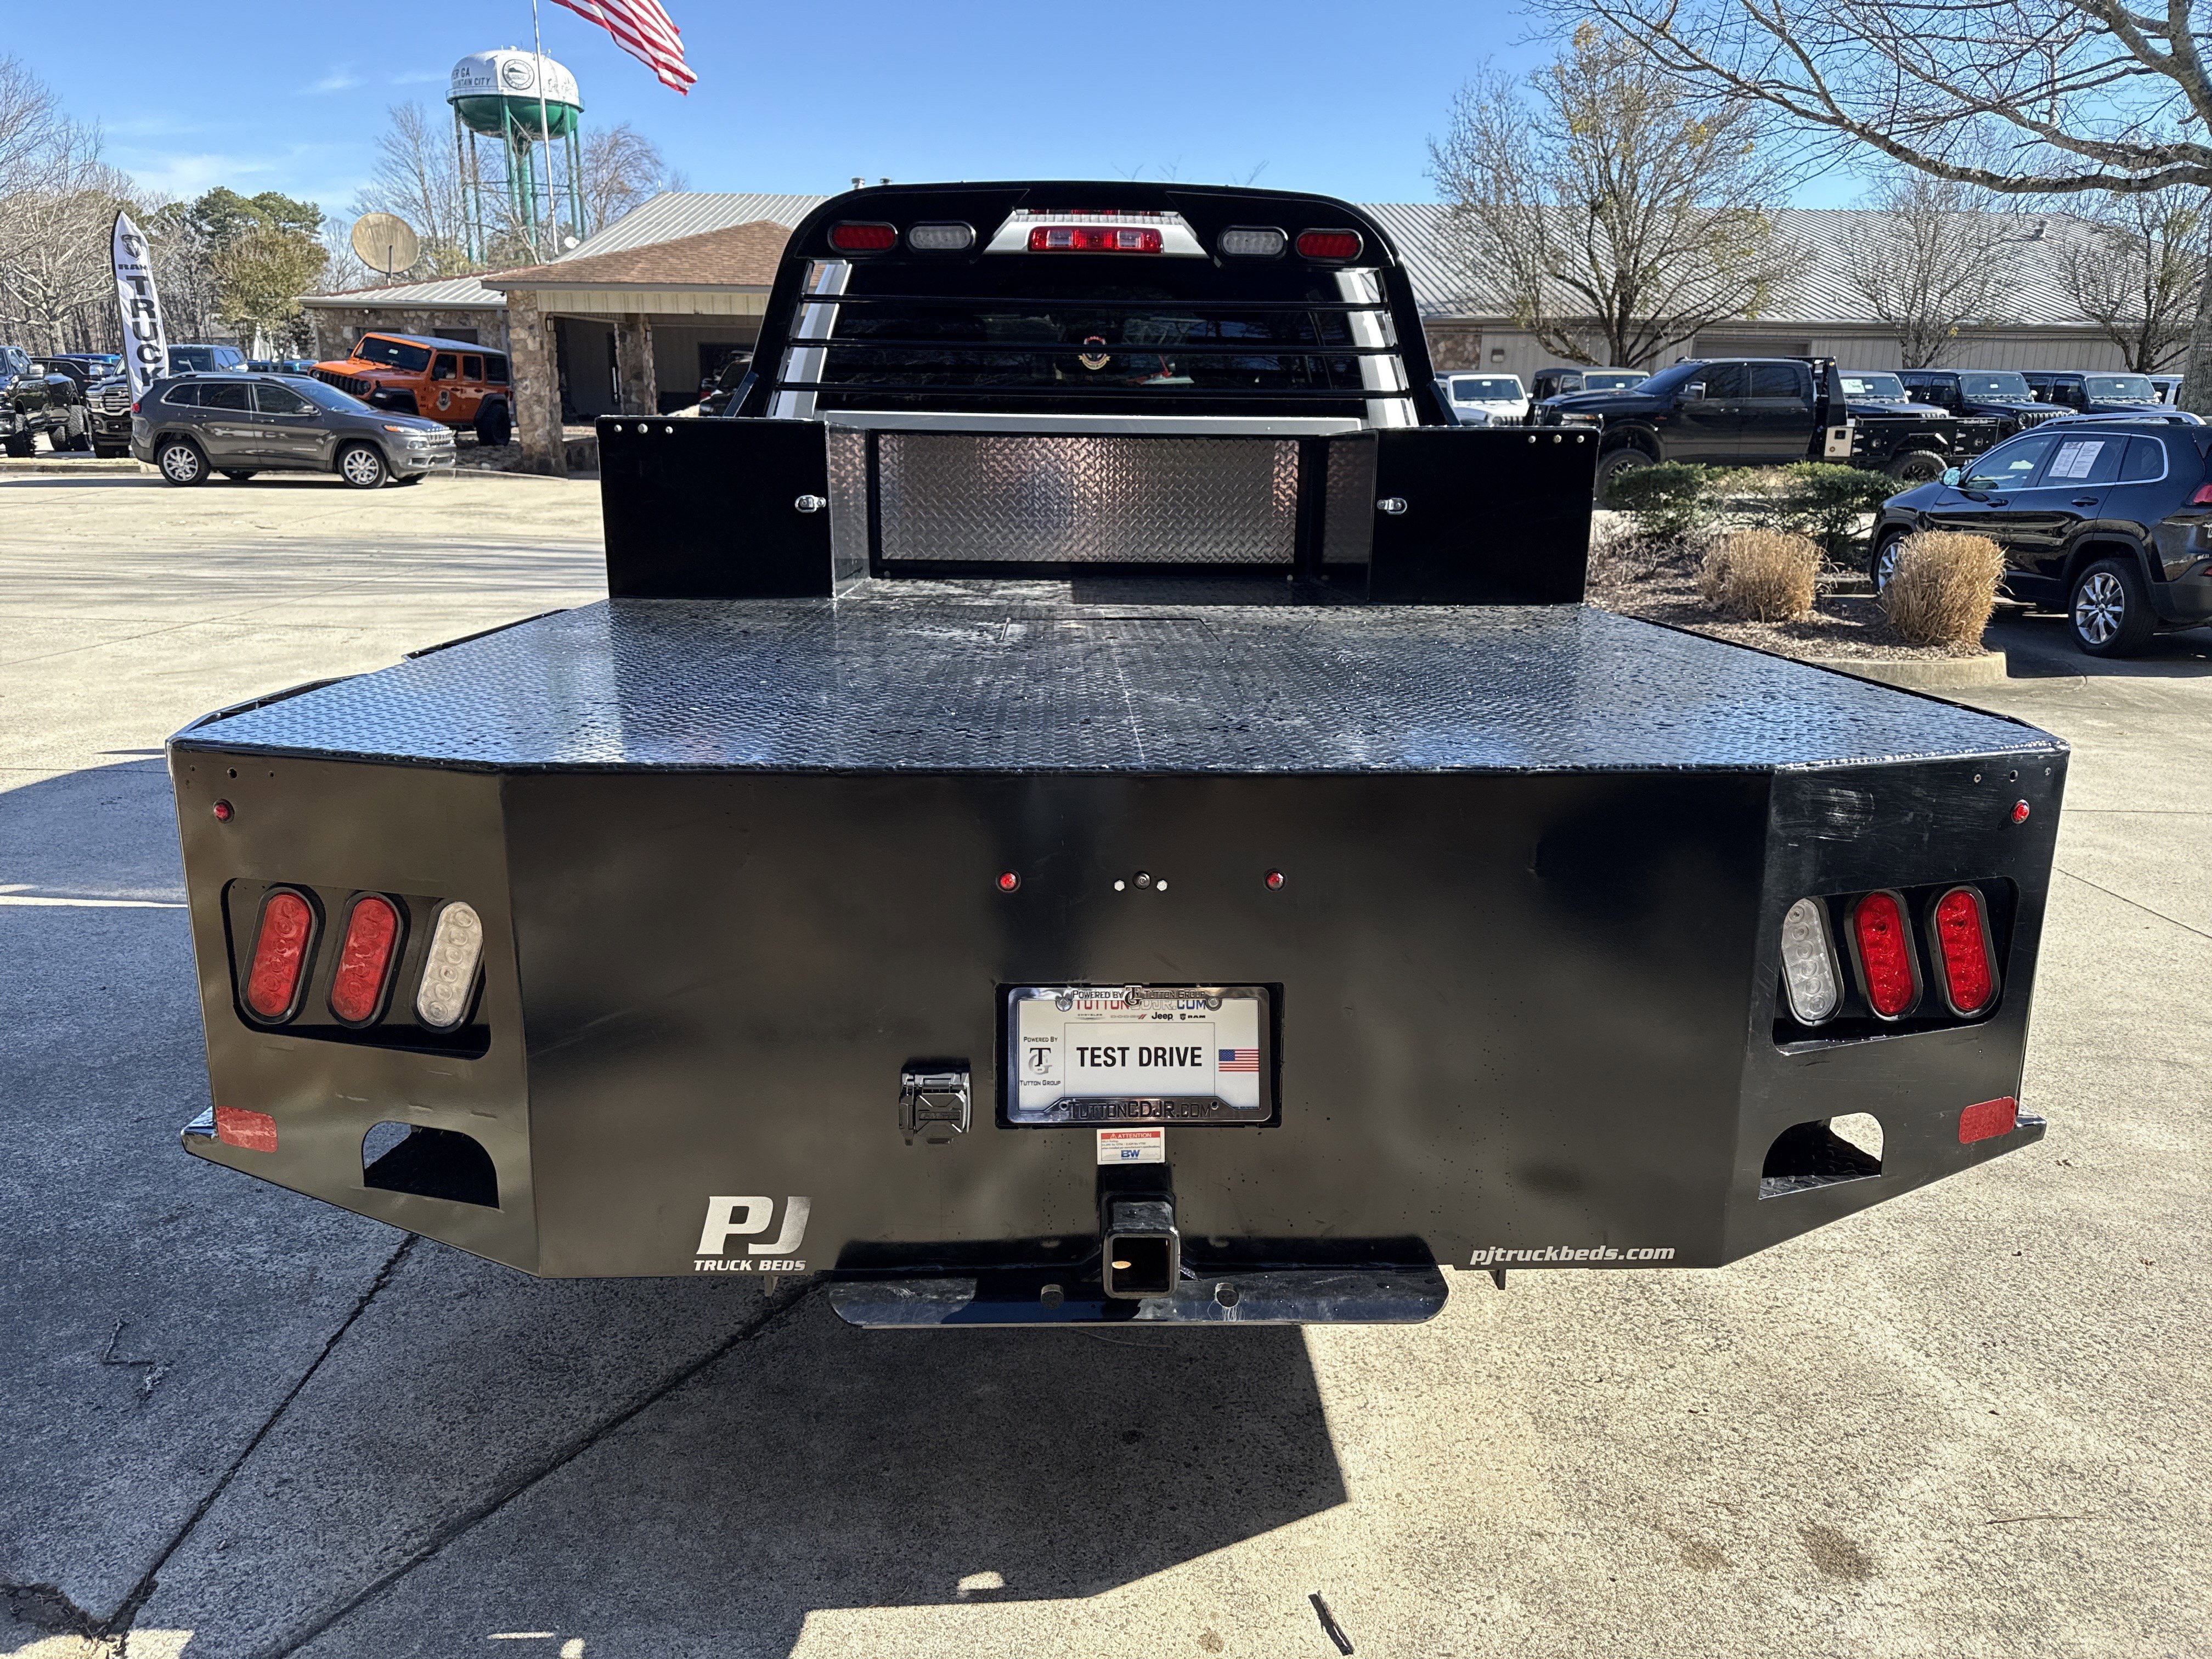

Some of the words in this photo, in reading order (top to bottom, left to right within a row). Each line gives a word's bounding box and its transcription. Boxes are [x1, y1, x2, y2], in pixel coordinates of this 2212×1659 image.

[474, 77, 491, 86] CITY
[126, 275, 166, 387] TRUCK
[1073, 990, 1110, 998] POWERED
[1144, 989, 1175, 998] TUTTON
[1178, 989, 1206, 999] GROUP
[1152, 1012, 1173, 1021] Jeep
[1076, 1046, 1129, 1067] TEST
[1138, 1046, 1202, 1067] DRIVE
[696, 1196, 812, 1255] PJ
[1469, 1245, 1675, 1266] pjtruckbeds.com
[693, 1260, 753, 1271] TRUCK
[758, 1260, 806, 1271] BEDS
